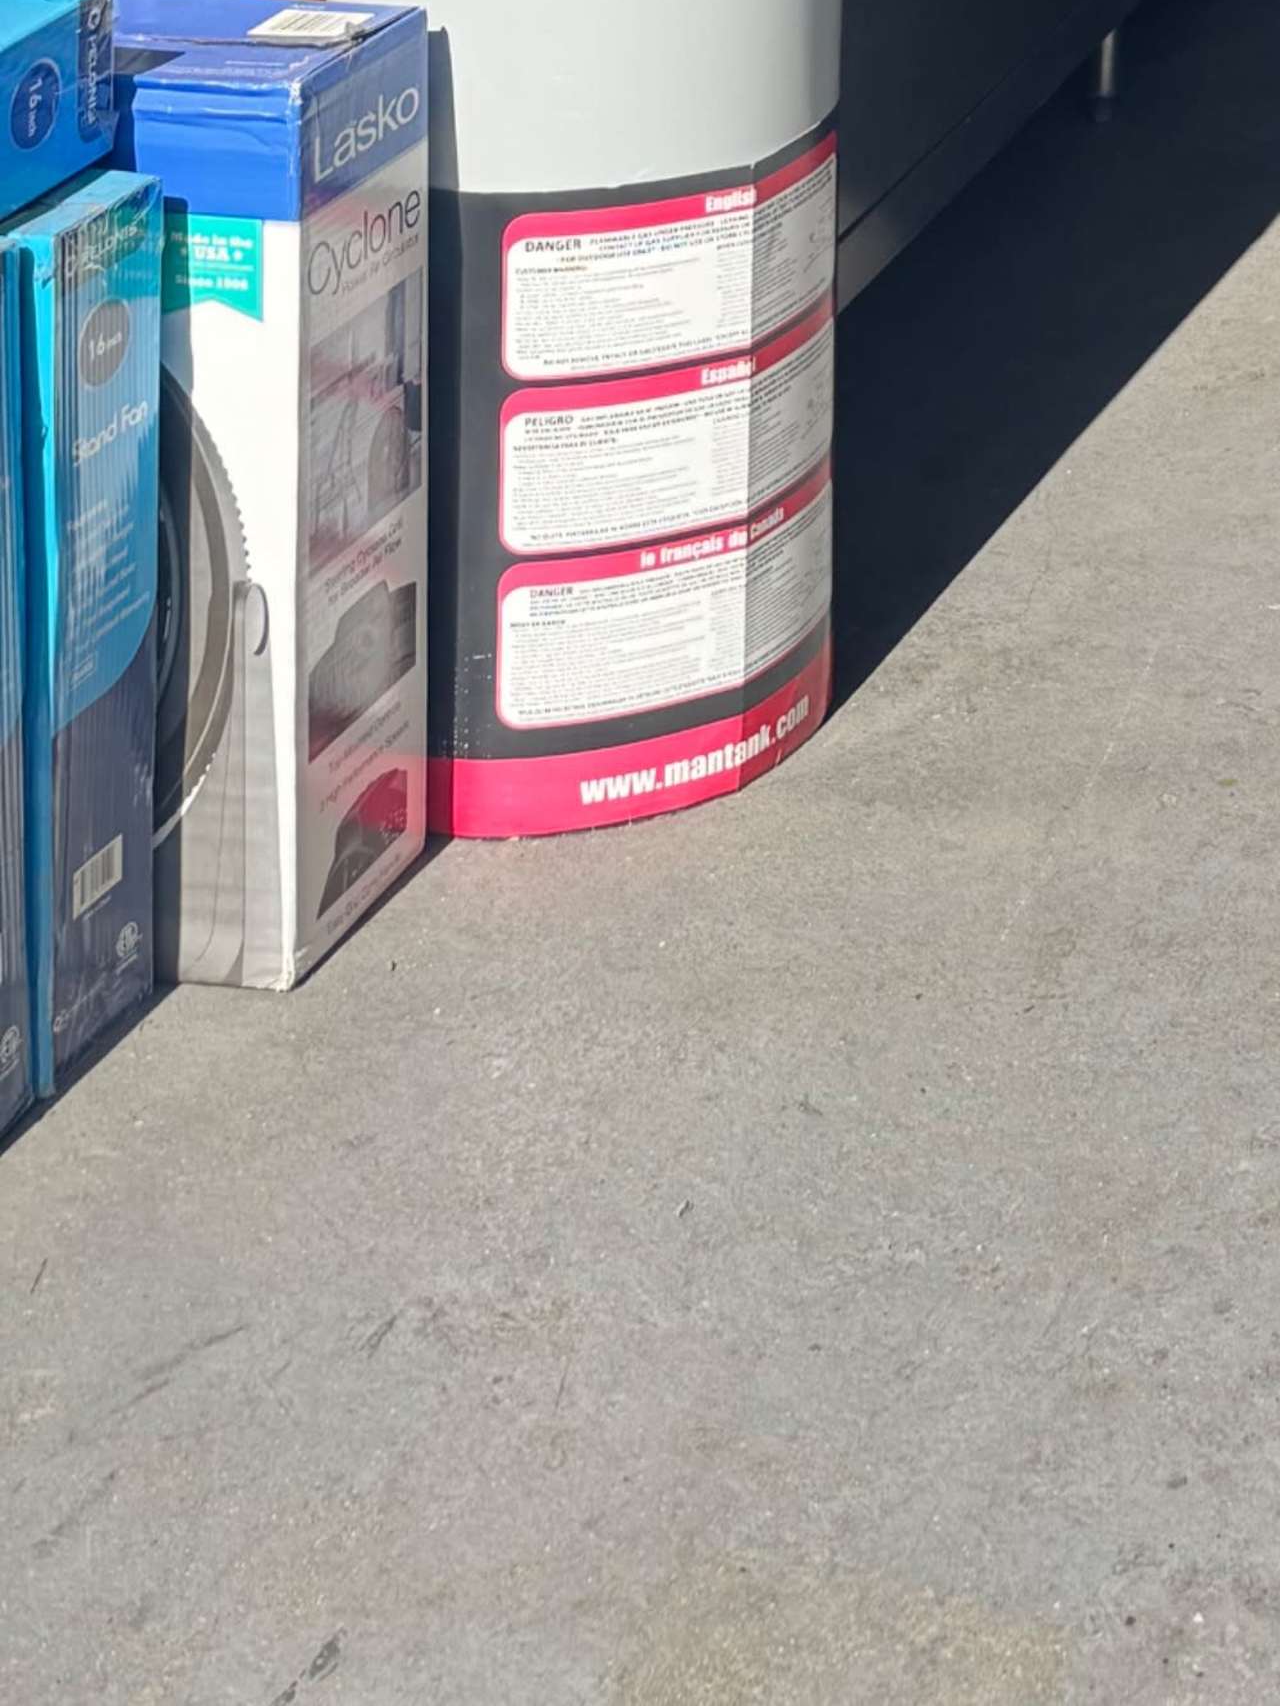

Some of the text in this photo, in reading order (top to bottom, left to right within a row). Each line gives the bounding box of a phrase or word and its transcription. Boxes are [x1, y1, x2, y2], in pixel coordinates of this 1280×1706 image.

[28, 76, 43, 109] 16
[312, 85, 420, 183] Lasko
[704, 184, 757, 214] English
[193, 247, 229, 262] USA
[229, 234, 254, 249] the
[307, 190, 421, 297] Cyclone
[524, 238, 582, 253] DANGER
[72, 400, 150, 467] Stand Fan
[524, 415, 574, 427] PELIGRO
[660, 533, 723, 563] français
[529, 586, 574, 599] DANGER
[579, 695, 811, 806] www.mantank.com
